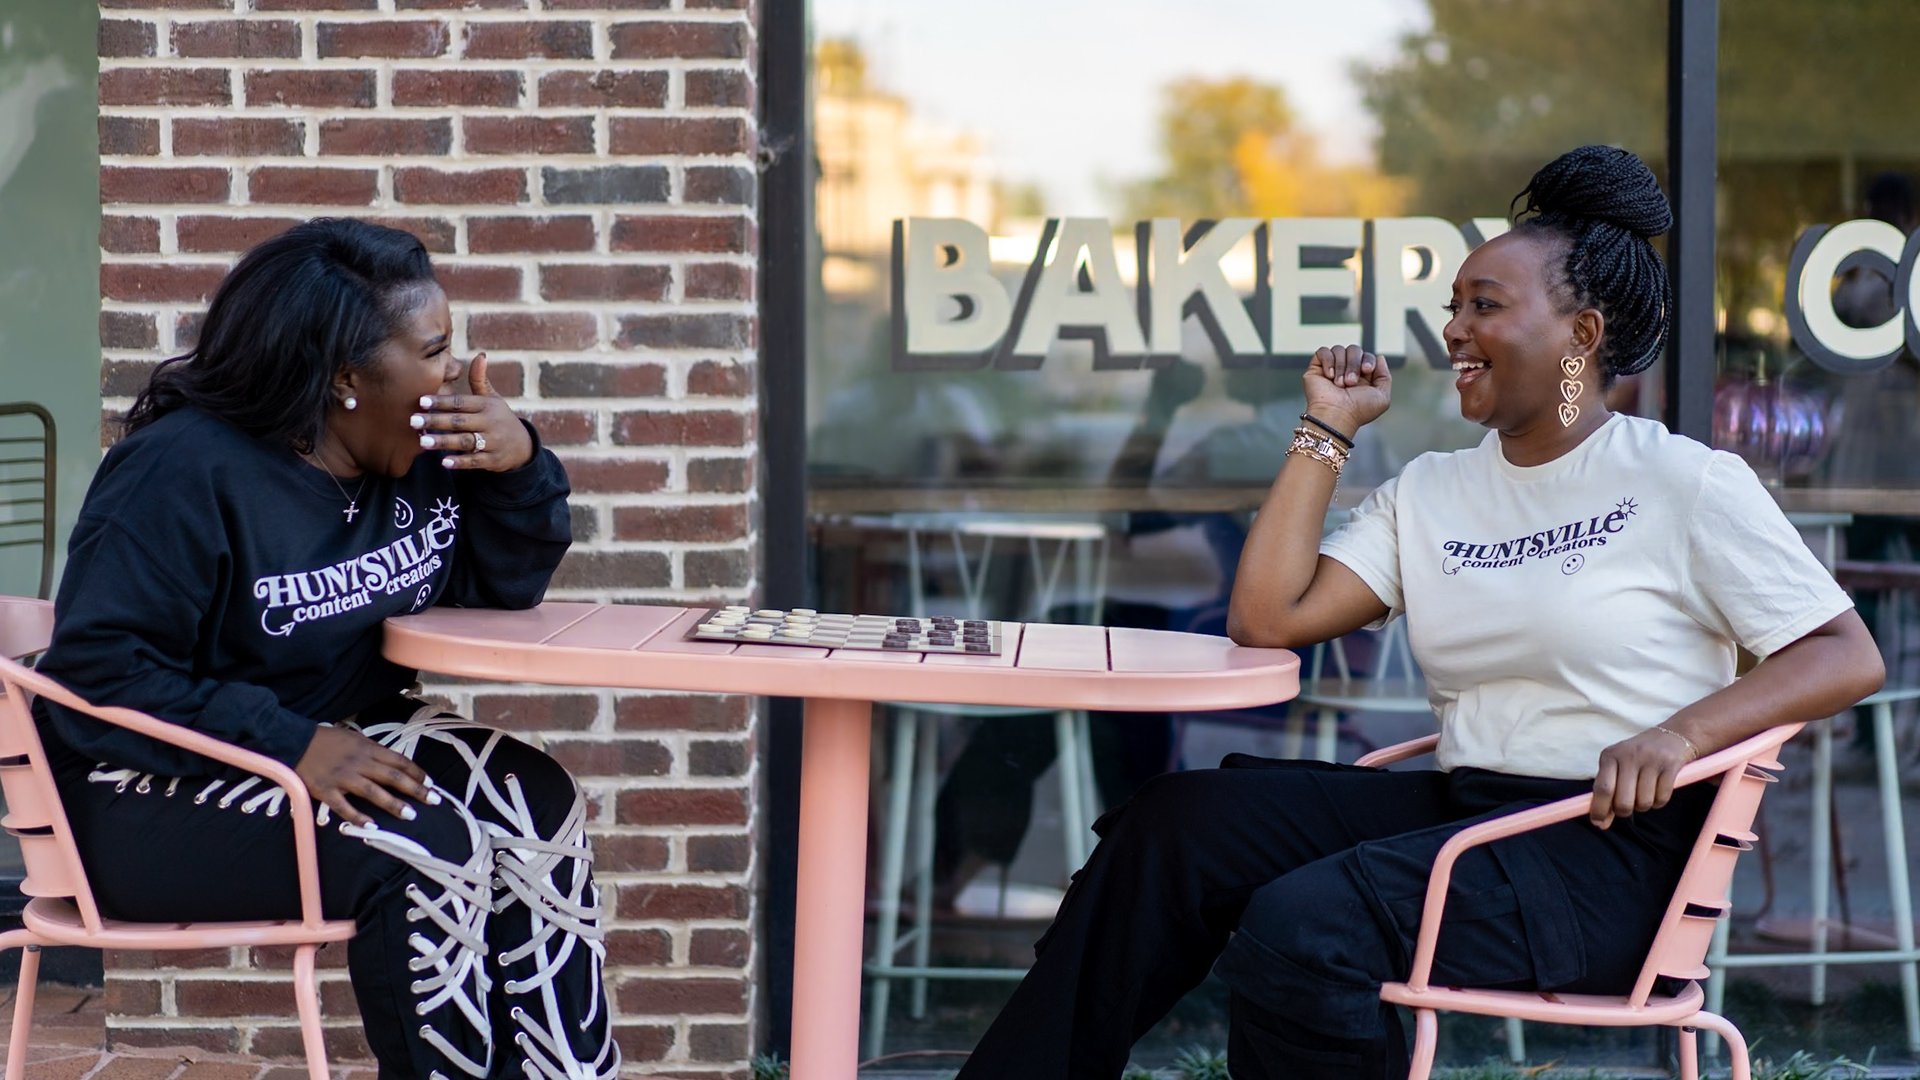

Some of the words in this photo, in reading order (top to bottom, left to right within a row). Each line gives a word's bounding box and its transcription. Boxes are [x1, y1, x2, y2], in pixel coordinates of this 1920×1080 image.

[893, 216, 1511, 369] BAKER
[1786, 218, 1920, 374] C
[1461, 555, 1525, 569] content
[1538, 536, 1607, 560] creators
[293, 588, 373, 623] content
[385, 554, 443, 596] creators
